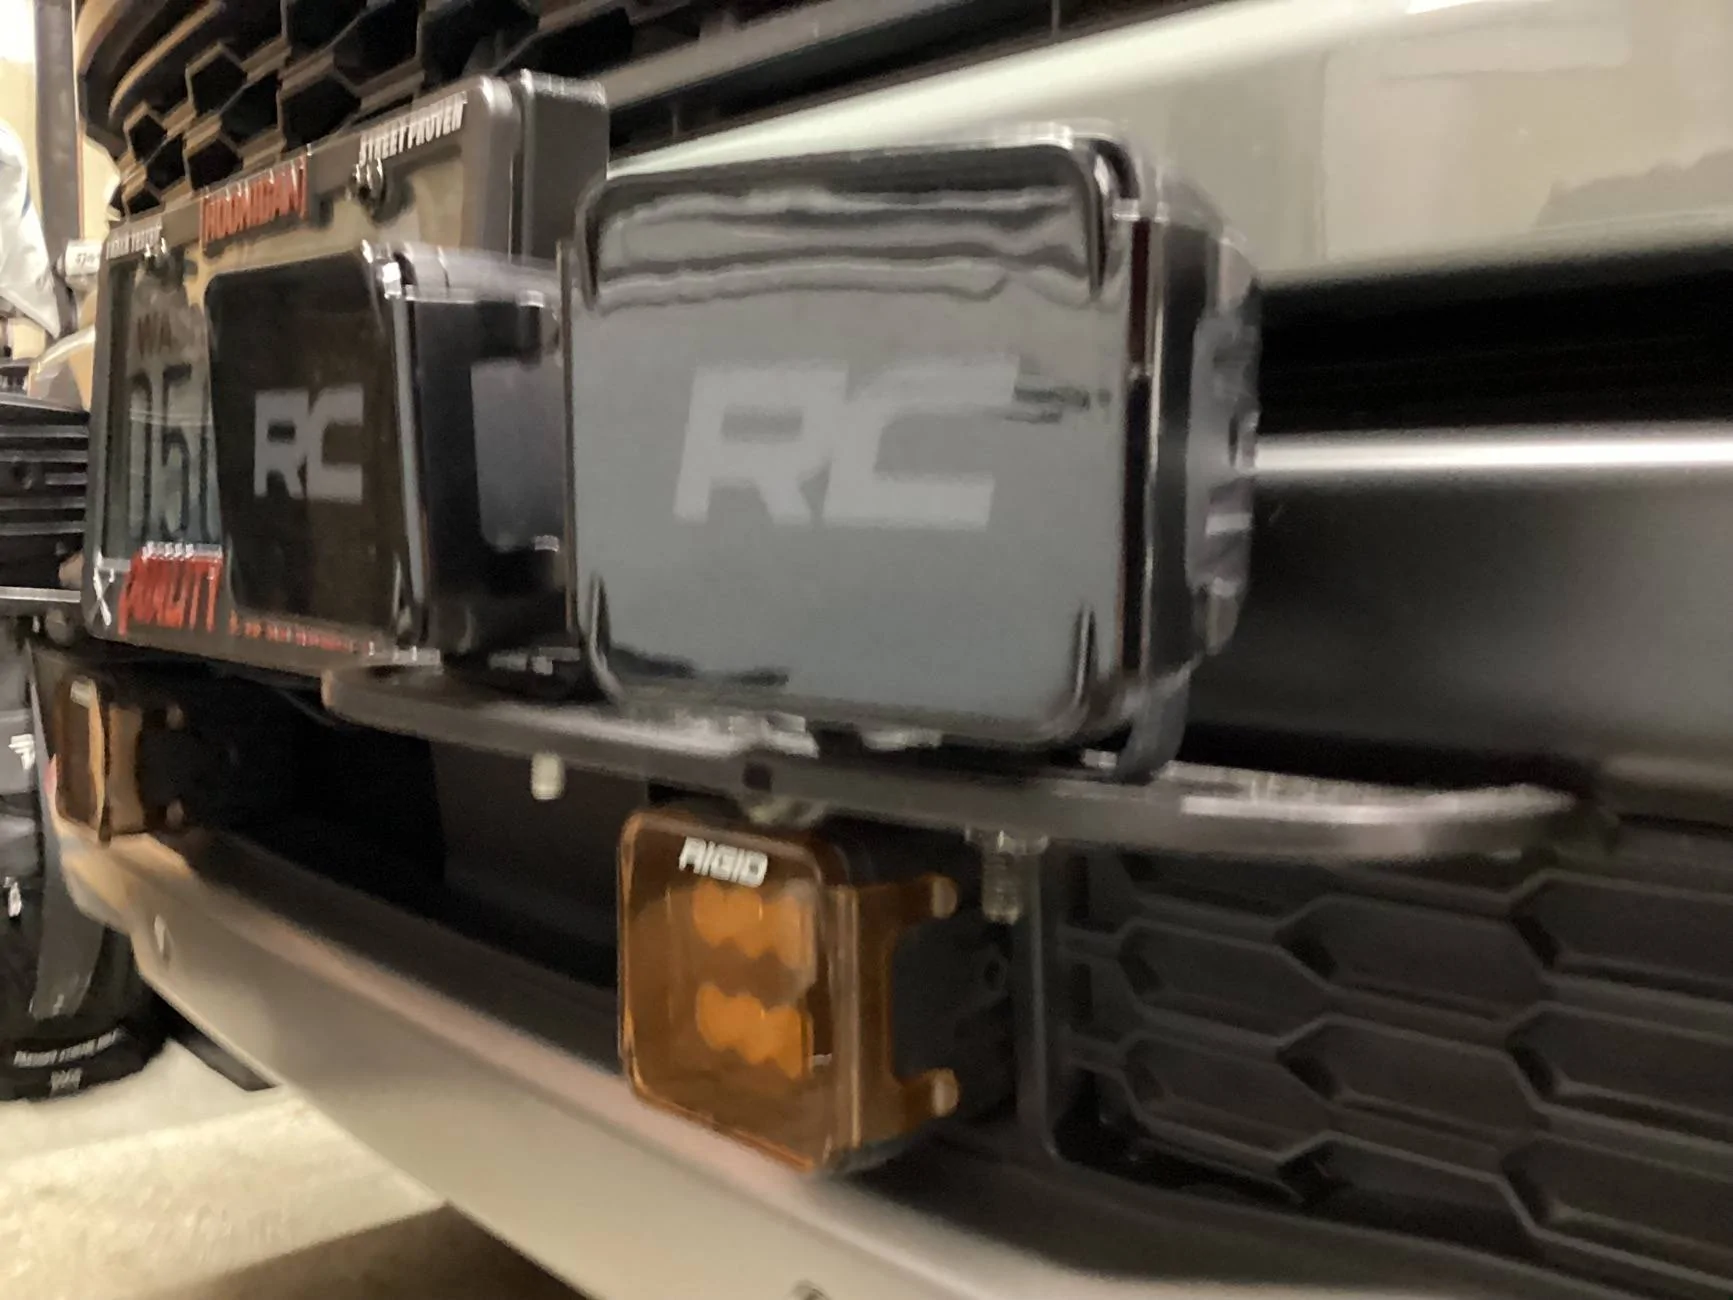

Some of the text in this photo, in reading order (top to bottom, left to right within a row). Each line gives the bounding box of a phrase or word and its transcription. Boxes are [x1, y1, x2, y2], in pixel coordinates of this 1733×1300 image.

[254, 384, 365, 504] RC
[672, 358, 1020, 531] RC
[679, 836, 768, 888] RIGID
